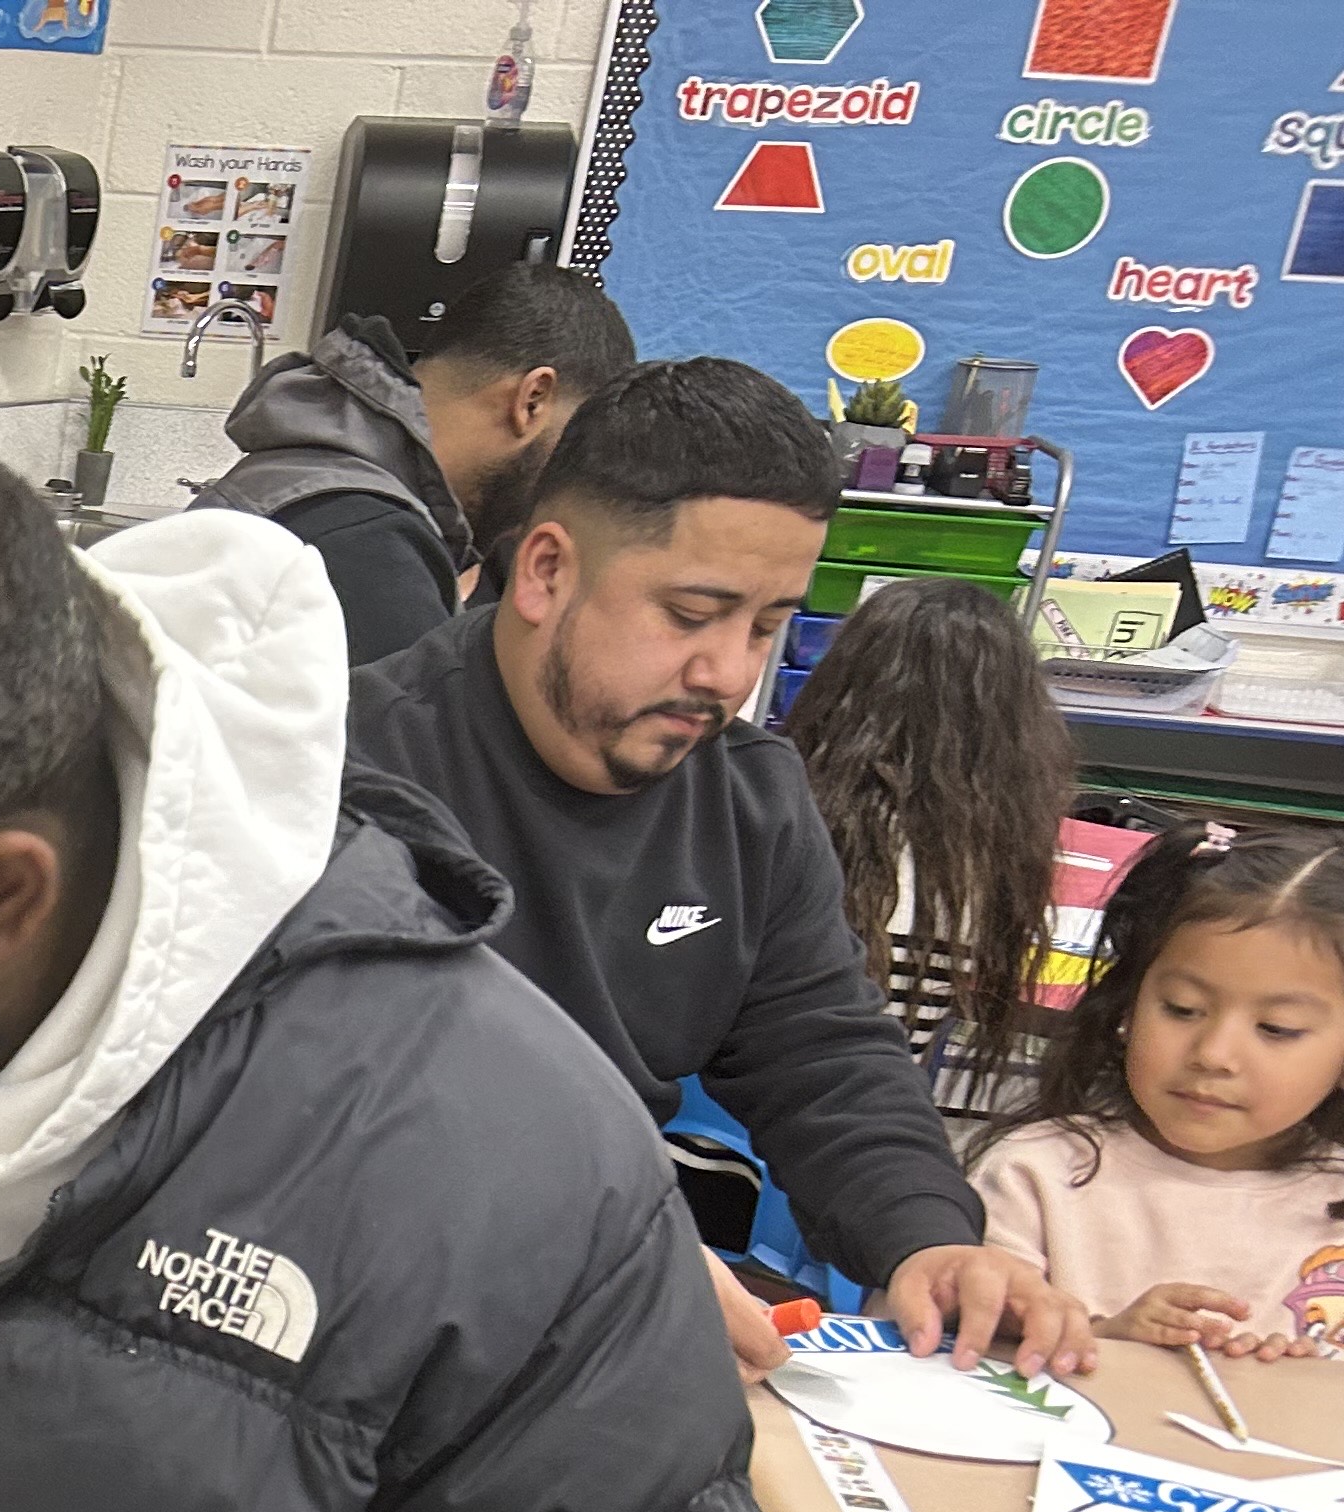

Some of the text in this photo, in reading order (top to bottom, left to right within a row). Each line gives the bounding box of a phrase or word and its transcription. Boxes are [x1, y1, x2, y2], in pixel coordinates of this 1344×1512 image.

[679, 79, 917, 123] trapezoid
[1005, 102, 1145, 143] circle
[174, 153, 304, 173] Wash your Hands
[849, 240, 953, 281] oval
[1112, 260, 1255, 304] heart
[658, 905, 708, 928] NIKE
[136, 1238, 262, 1310] NORTH
[205, 1227, 275, 1281] THE
[158, 1282, 252, 1336] FACE
